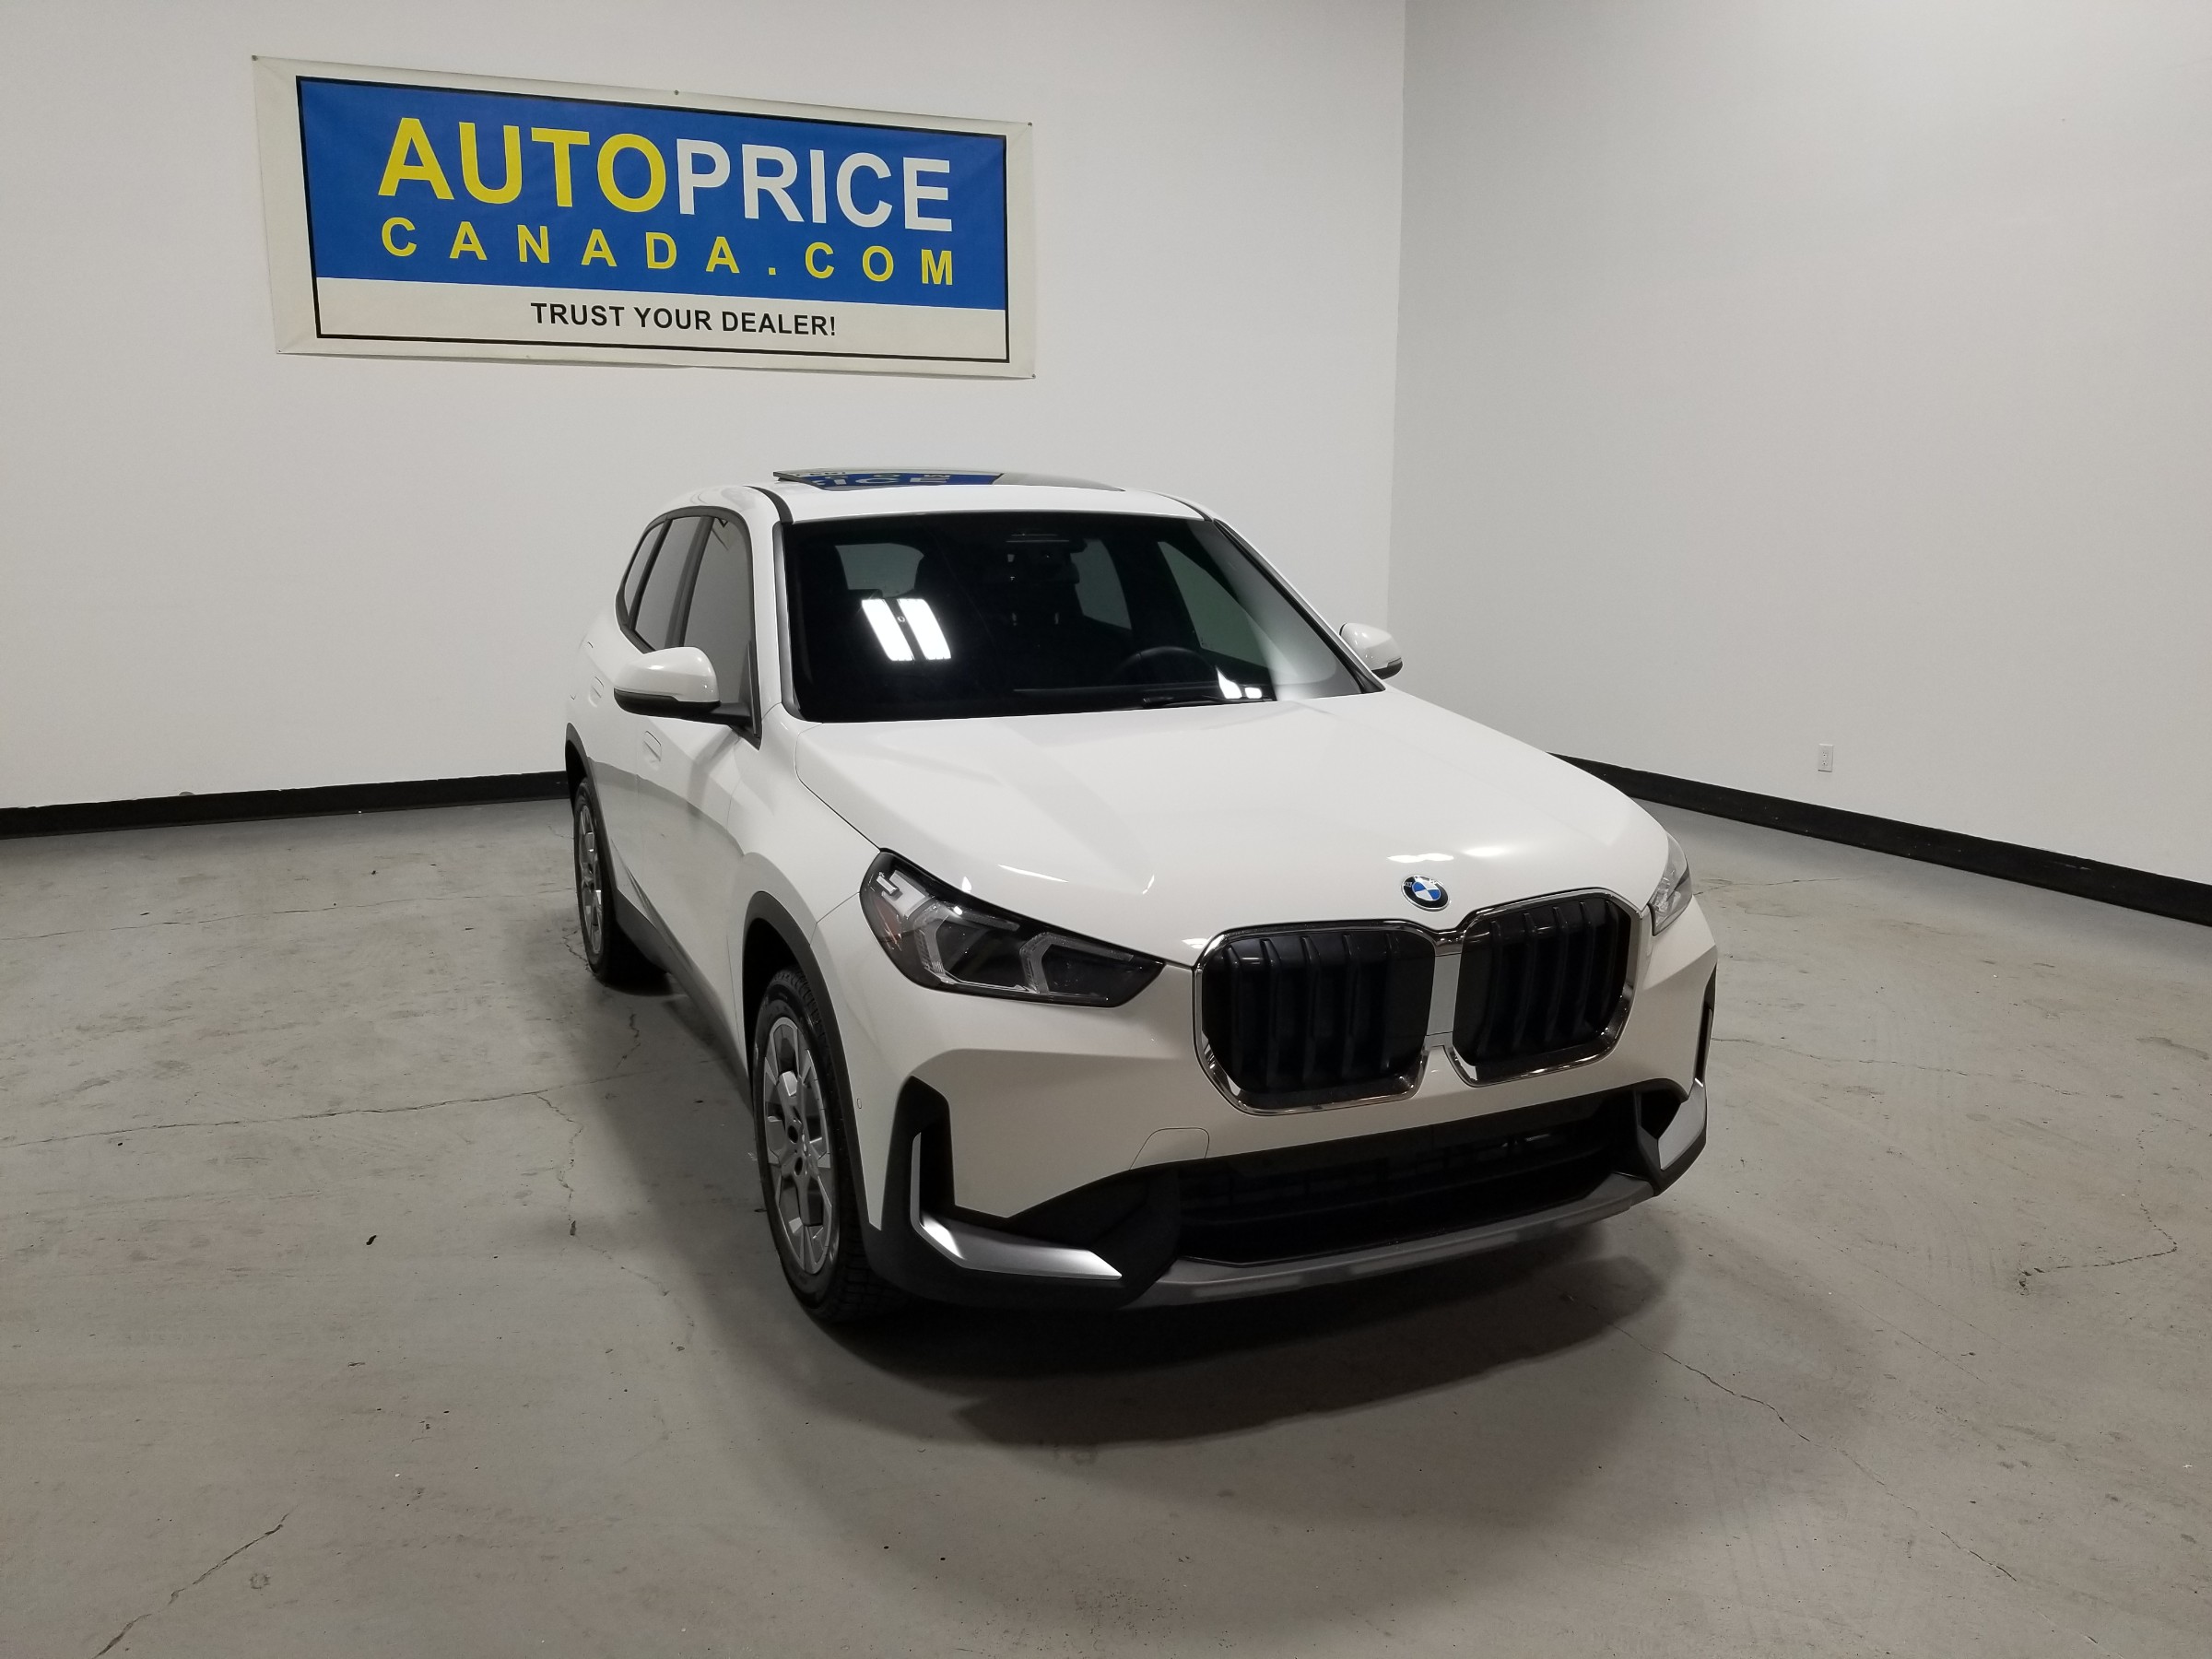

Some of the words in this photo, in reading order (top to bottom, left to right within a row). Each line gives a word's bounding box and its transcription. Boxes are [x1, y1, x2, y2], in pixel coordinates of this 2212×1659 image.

[377, 116, 953, 232] AUTOPRICE
[380, 216, 955, 286] CANADA.COM
[530, 302, 625, 327] TRUST
[633, 306, 712, 331] YOUR
[722, 311, 836, 336] DEALER!
